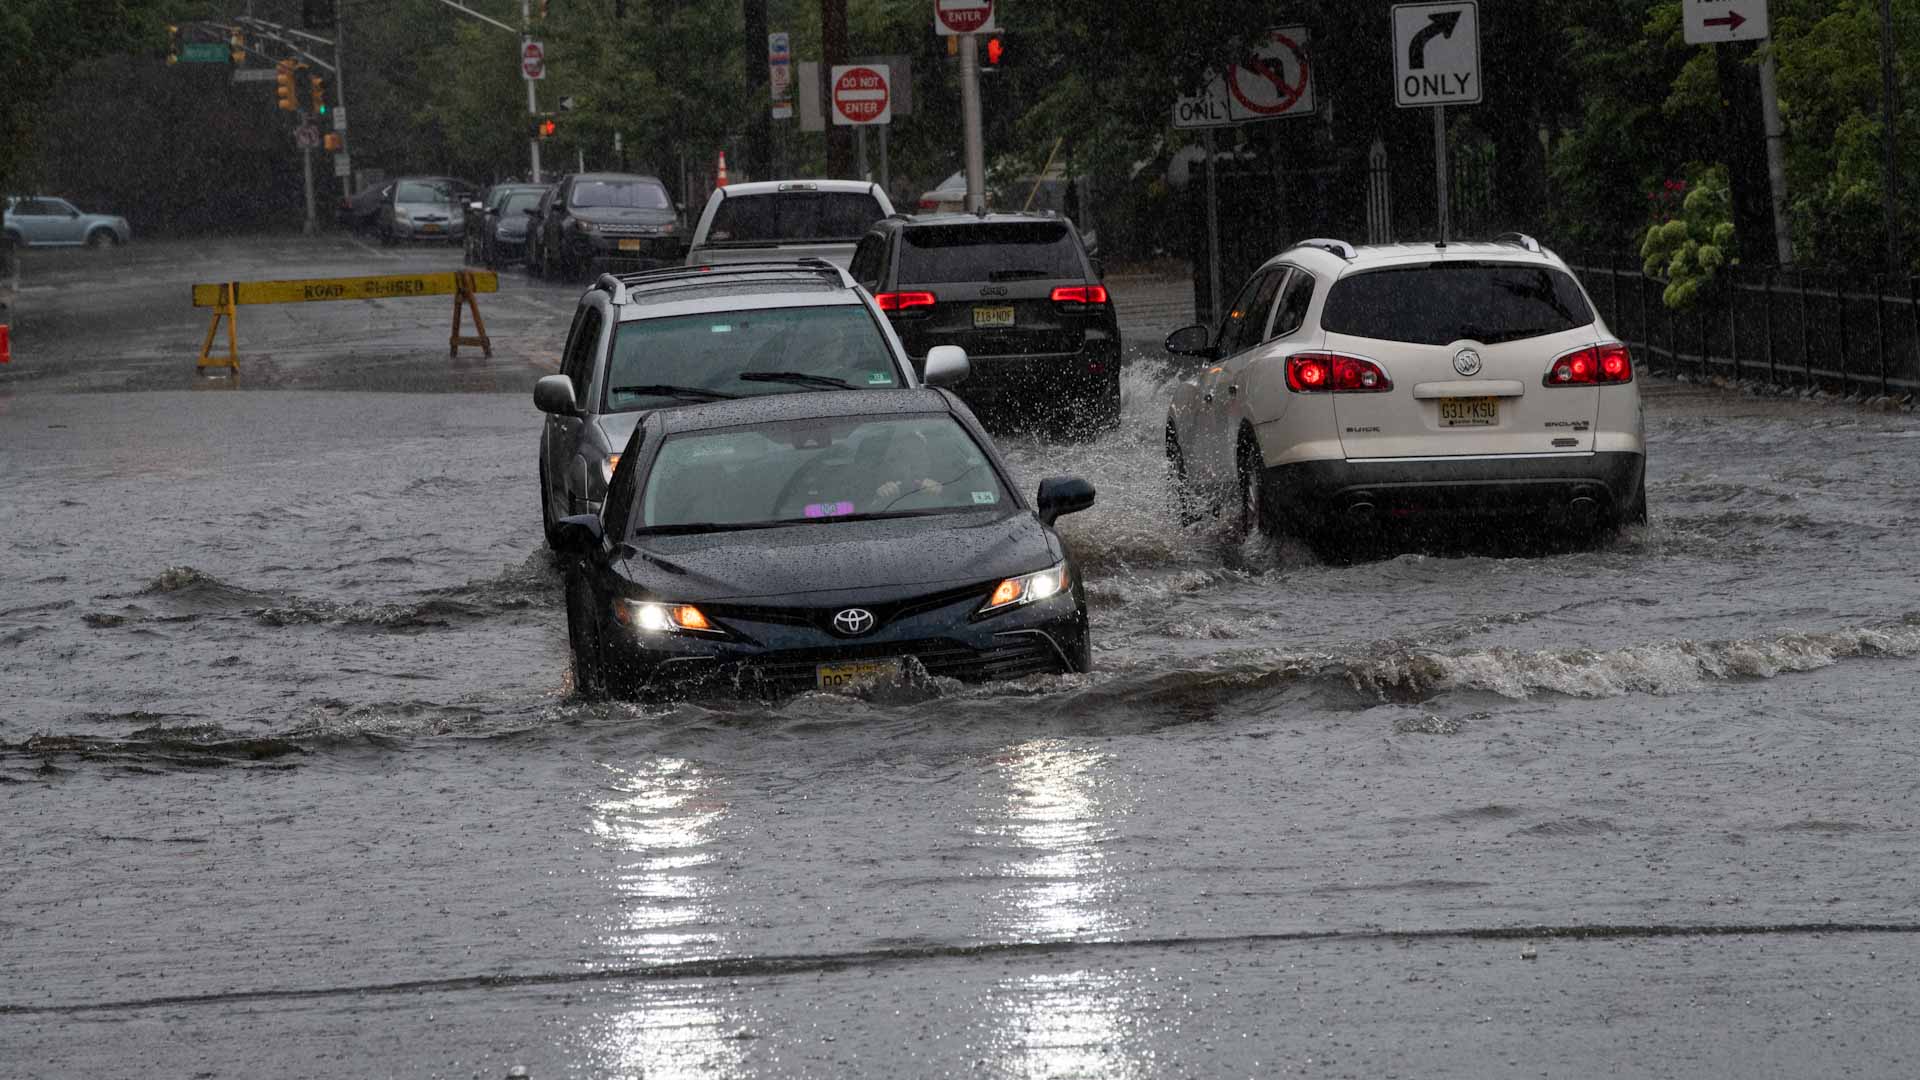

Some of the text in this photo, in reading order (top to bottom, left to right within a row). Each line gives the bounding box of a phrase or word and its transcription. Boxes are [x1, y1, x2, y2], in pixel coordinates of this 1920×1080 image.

[948, 12, 981, 22] ENTER
[841, 77, 880, 88] DO NOT
[1405, 72, 1470, 97] ONLY
[844, 103, 878, 113] ENTER
[304, 280, 423, 298] ROAD CLOSED
[980, 286, 1008, 296] Jeep
